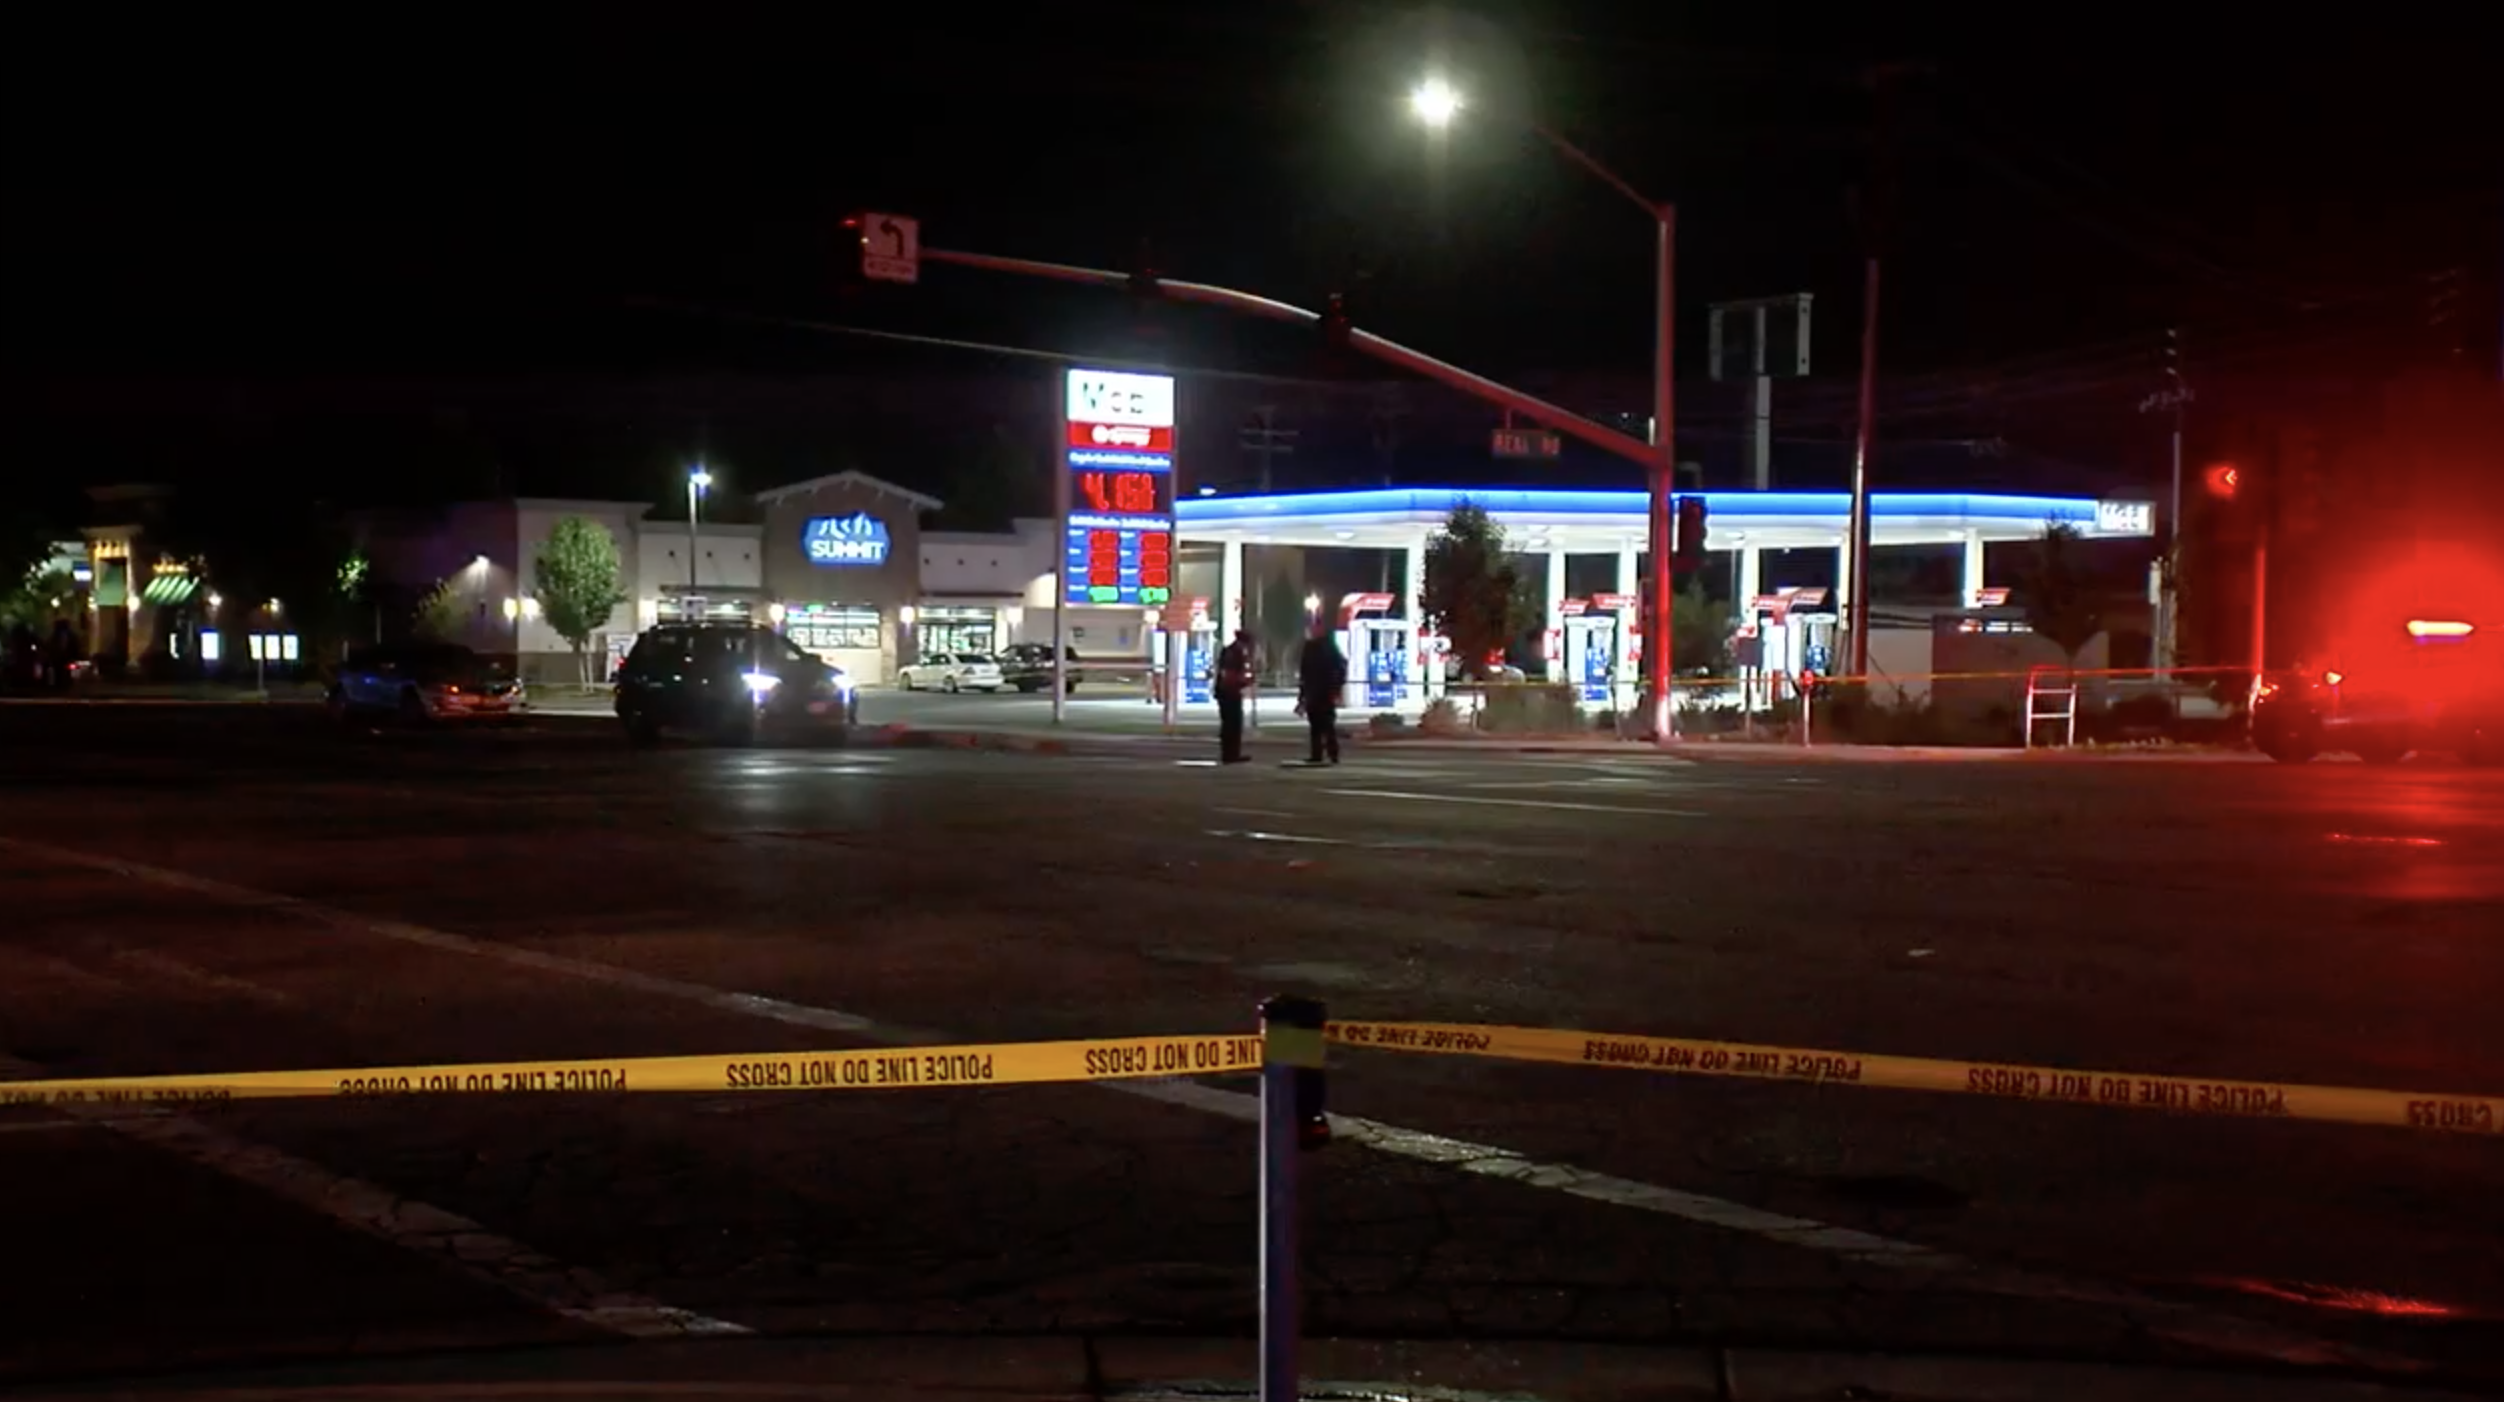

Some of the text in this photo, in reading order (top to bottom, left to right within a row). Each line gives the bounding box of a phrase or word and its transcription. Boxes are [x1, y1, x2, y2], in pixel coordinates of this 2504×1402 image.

[812, 540, 884, 559] SUMMIT
[1086, 1047, 1146, 1074] CROSS
[1153, 1044, 1188, 1070] NOT
[1195, 1041, 1219, 1067] DO
[1584, 1041, 1861, 1080] POLICE LINE DO NOT CROSS
[467, 1074, 493, 1093] DO
[502, 1072, 547, 1092] LINE
[555, 1069, 625, 1092] POLICE
[727, 1054, 993, 1088] POLICE LINE DO NOT CROSS
[1967, 1068, 2283, 1113] POLICE LINE DO NOT CROSS
[2408, 1101, 2492, 1129] CROSS
